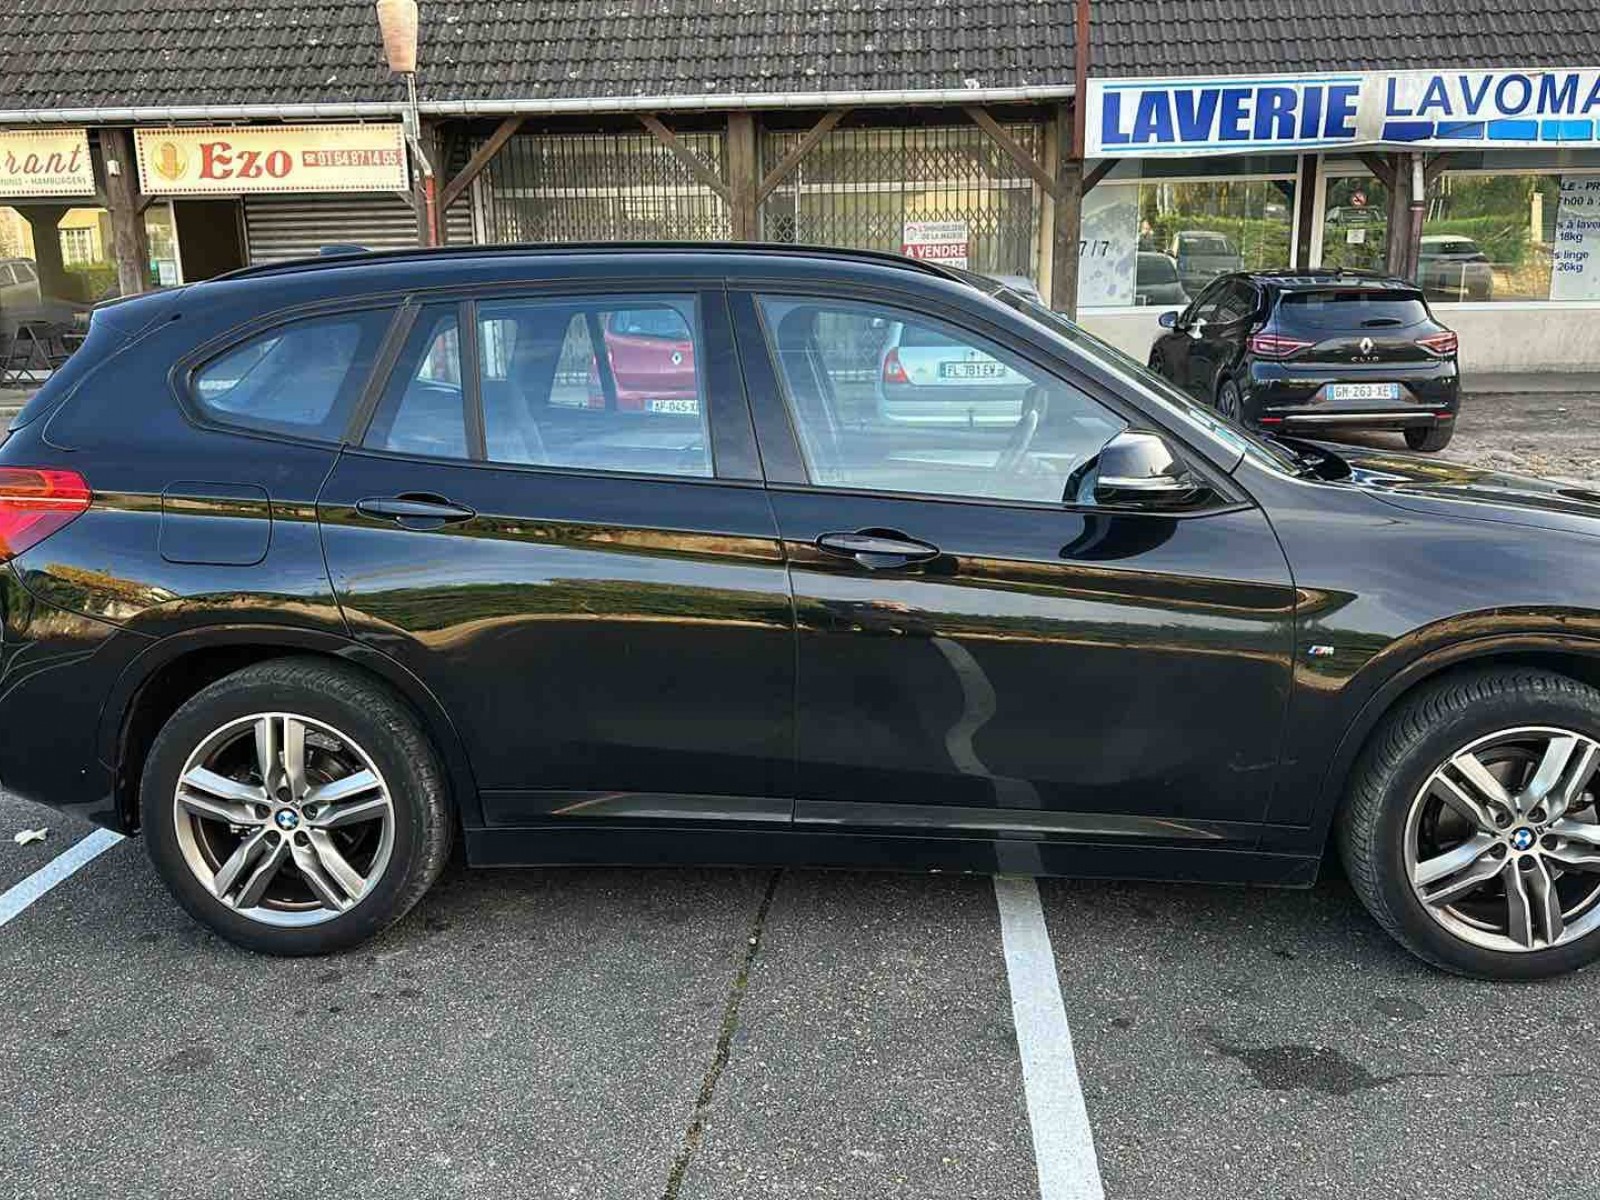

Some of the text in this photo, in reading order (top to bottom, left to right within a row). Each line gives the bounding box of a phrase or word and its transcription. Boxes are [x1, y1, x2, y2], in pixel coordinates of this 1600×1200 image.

[1101, 85, 1360, 145] LAVERIE
[4, 144, 81, 175] rant
[917, 244, 966, 258] VENDRE
